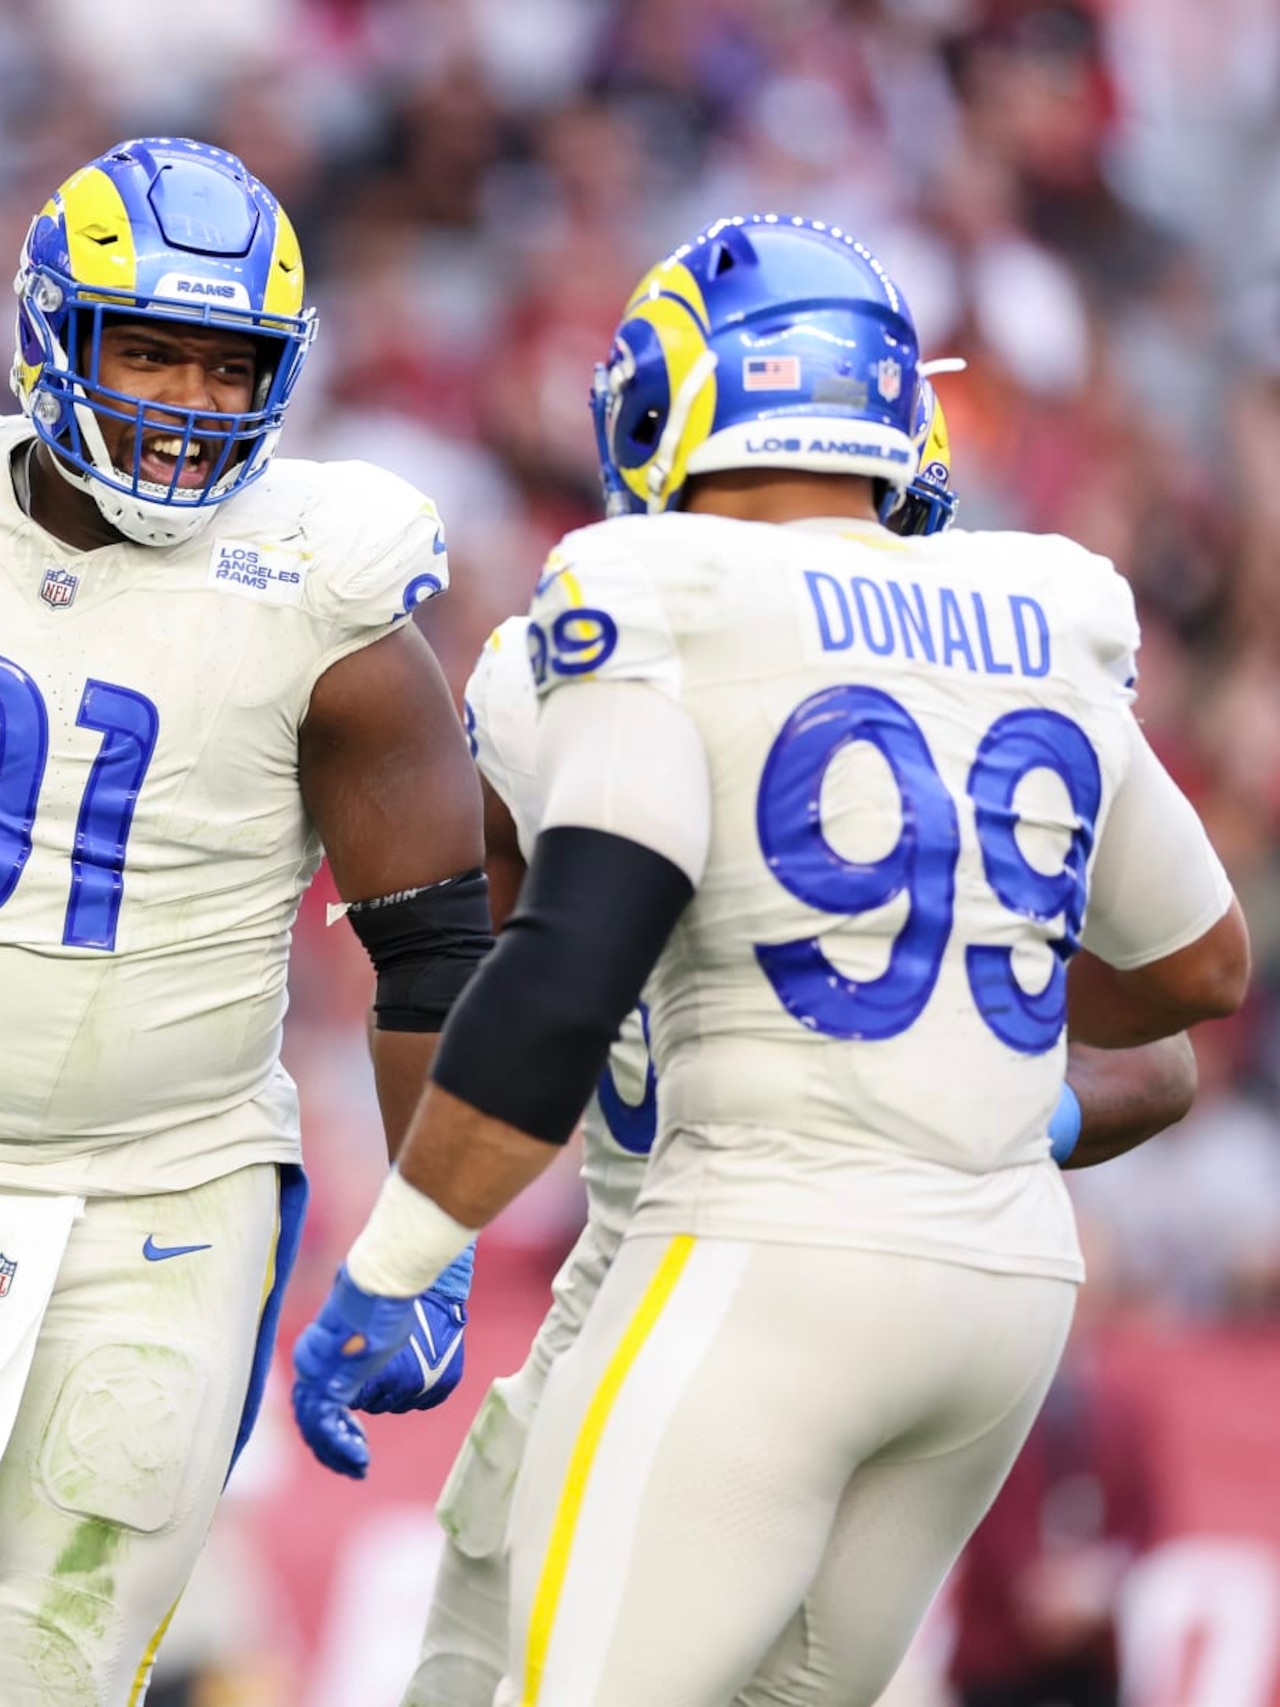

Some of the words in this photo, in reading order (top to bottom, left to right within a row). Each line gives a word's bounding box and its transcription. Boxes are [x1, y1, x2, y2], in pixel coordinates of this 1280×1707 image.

[176, 280, 236, 298] RAMS
[746, 438, 801, 453] LOS
[808, 440, 910, 464] ANGELES
[220, 547, 259, 563] LOS
[215, 569, 268, 590] RAMS
[217, 560, 301, 584] ANGELES
[804, 570, 1052, 679] DONALD
[754, 684, 1103, 1056] 99
